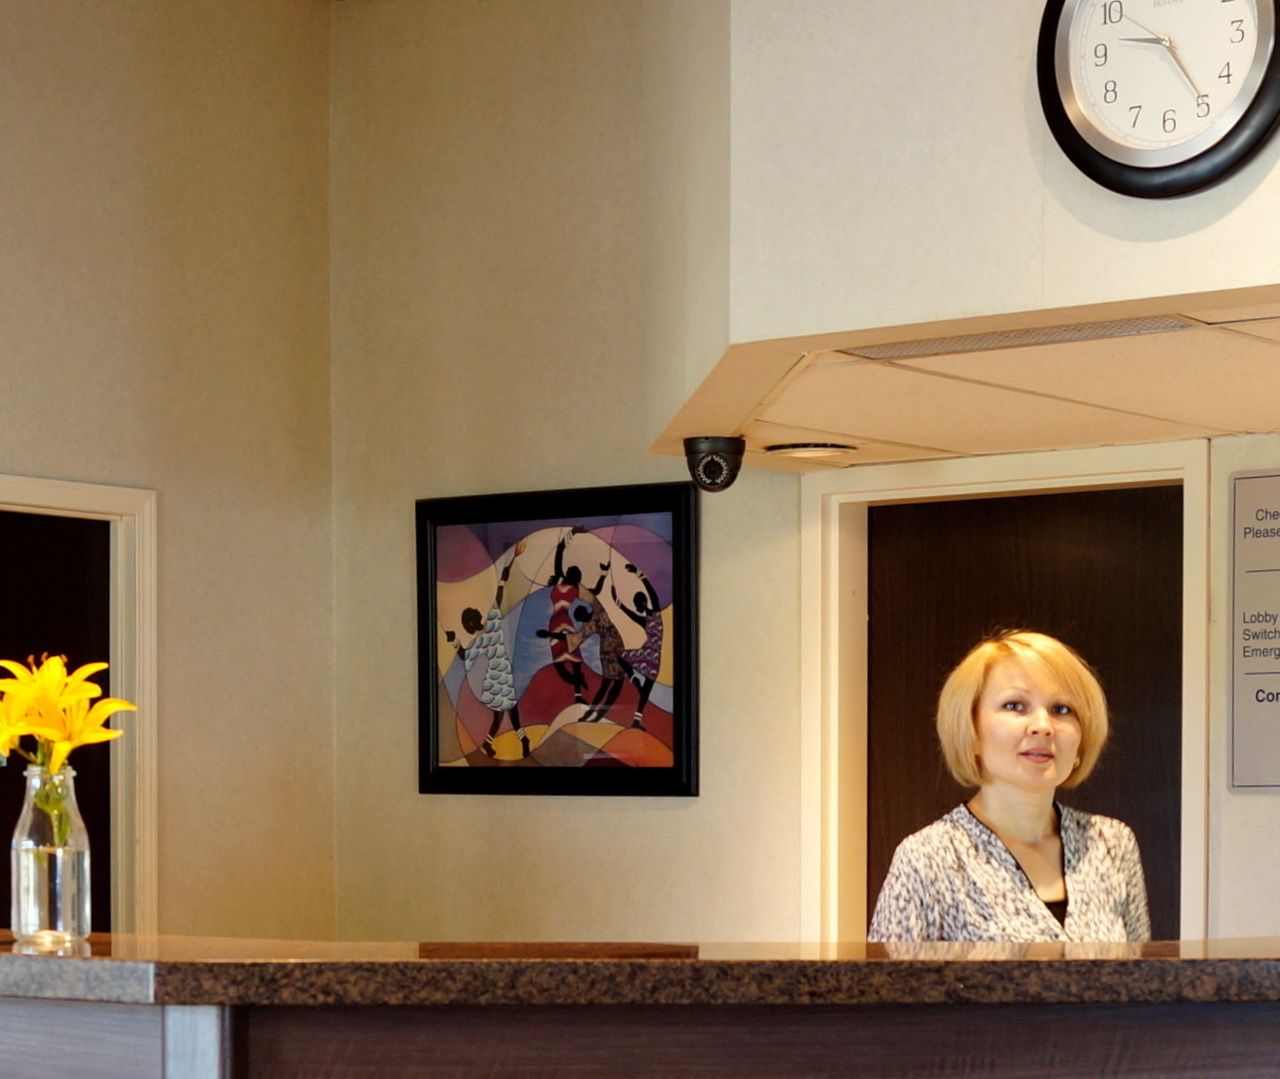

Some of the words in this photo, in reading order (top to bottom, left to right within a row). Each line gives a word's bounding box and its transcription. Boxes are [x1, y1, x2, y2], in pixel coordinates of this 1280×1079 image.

[1101, 0, 1124, 25] 10
[1231, 19, 1244, 43] 3
[1094, 44, 1107, 66] 9
[1218, 62, 1232, 83] 4
[1104, 80, 1117, 103] 8
[1129, 105, 1142, 128] 7
[1197, 93, 1210, 117] 5
[1163, 110, 1176, 133] 6
[1243, 612, 1278, 625] Lobby
